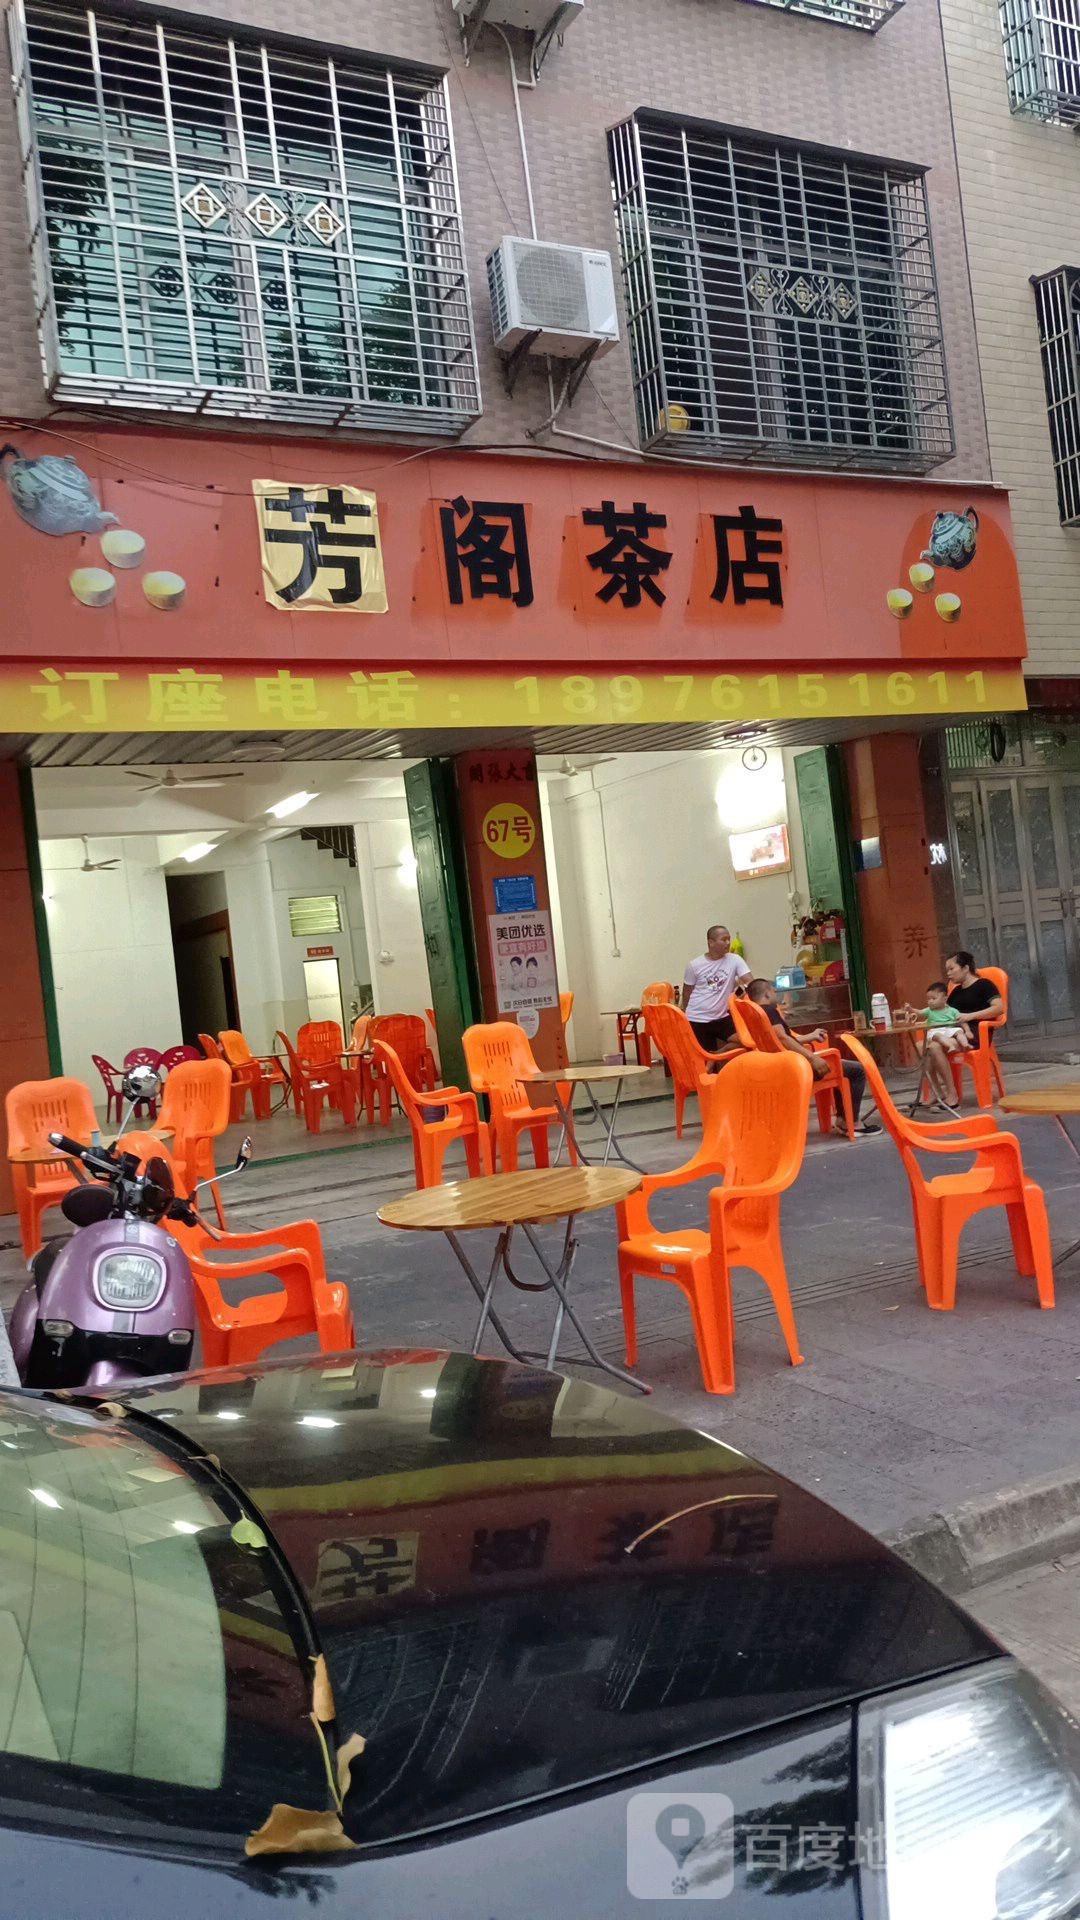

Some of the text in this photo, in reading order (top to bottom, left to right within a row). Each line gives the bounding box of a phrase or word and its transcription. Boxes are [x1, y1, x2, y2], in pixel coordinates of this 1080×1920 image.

[264, 487, 783, 607] 芳阁茶店
[486, 816, 532, 843] 67号
[496, 924, 546, 940] 美团优选
